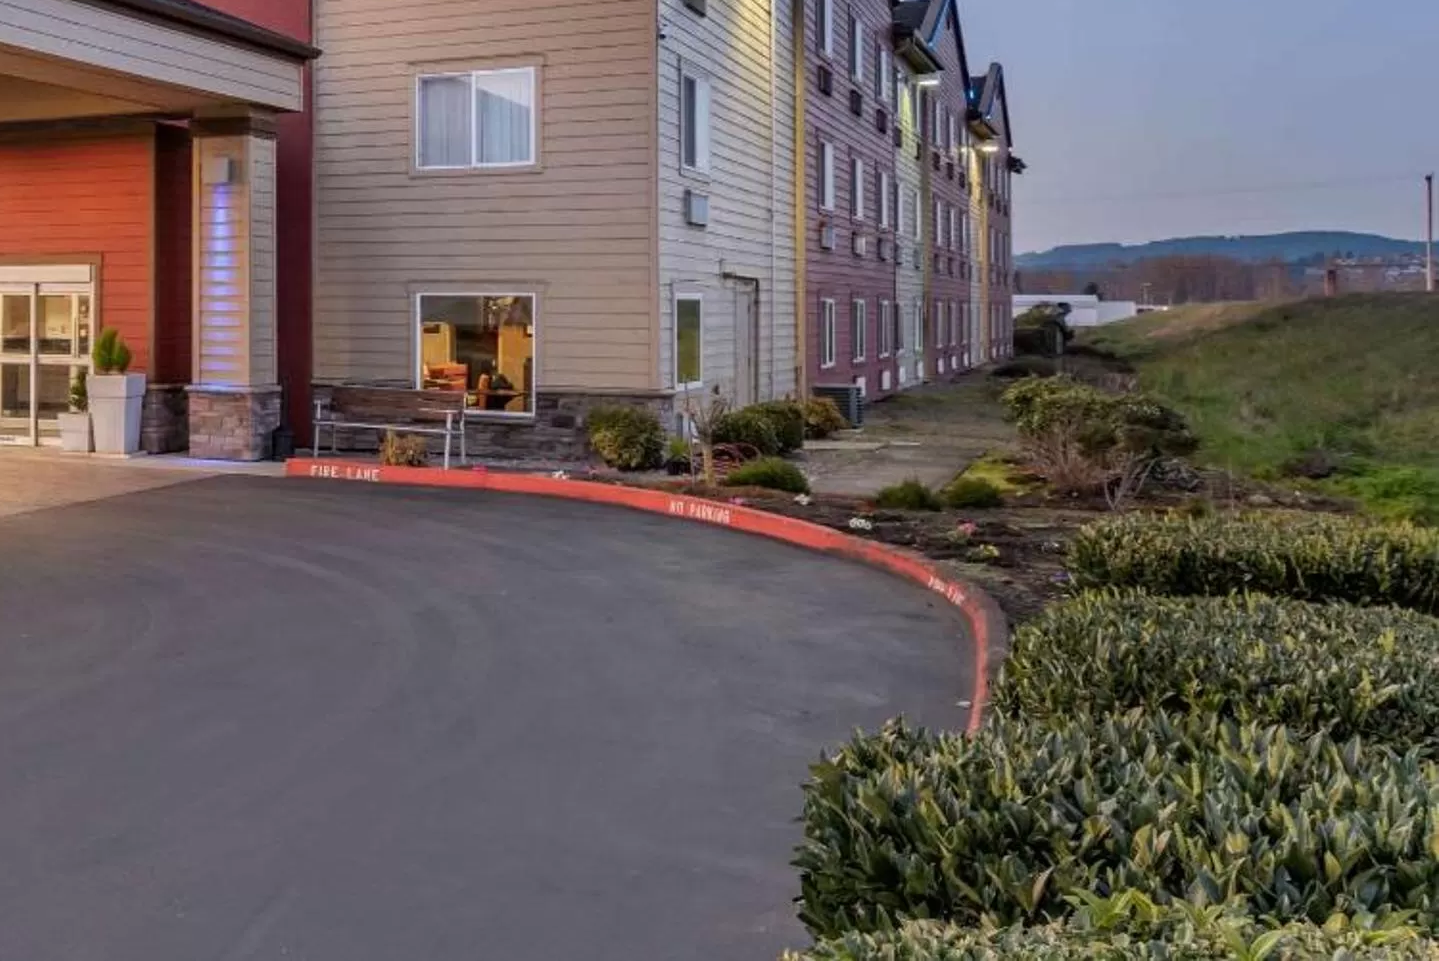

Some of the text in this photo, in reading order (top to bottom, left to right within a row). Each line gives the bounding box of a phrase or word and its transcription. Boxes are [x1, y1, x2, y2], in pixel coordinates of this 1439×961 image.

[311, 465, 381, 481] FIRE LANE
[669, 500, 731, 524] NO PARKING
